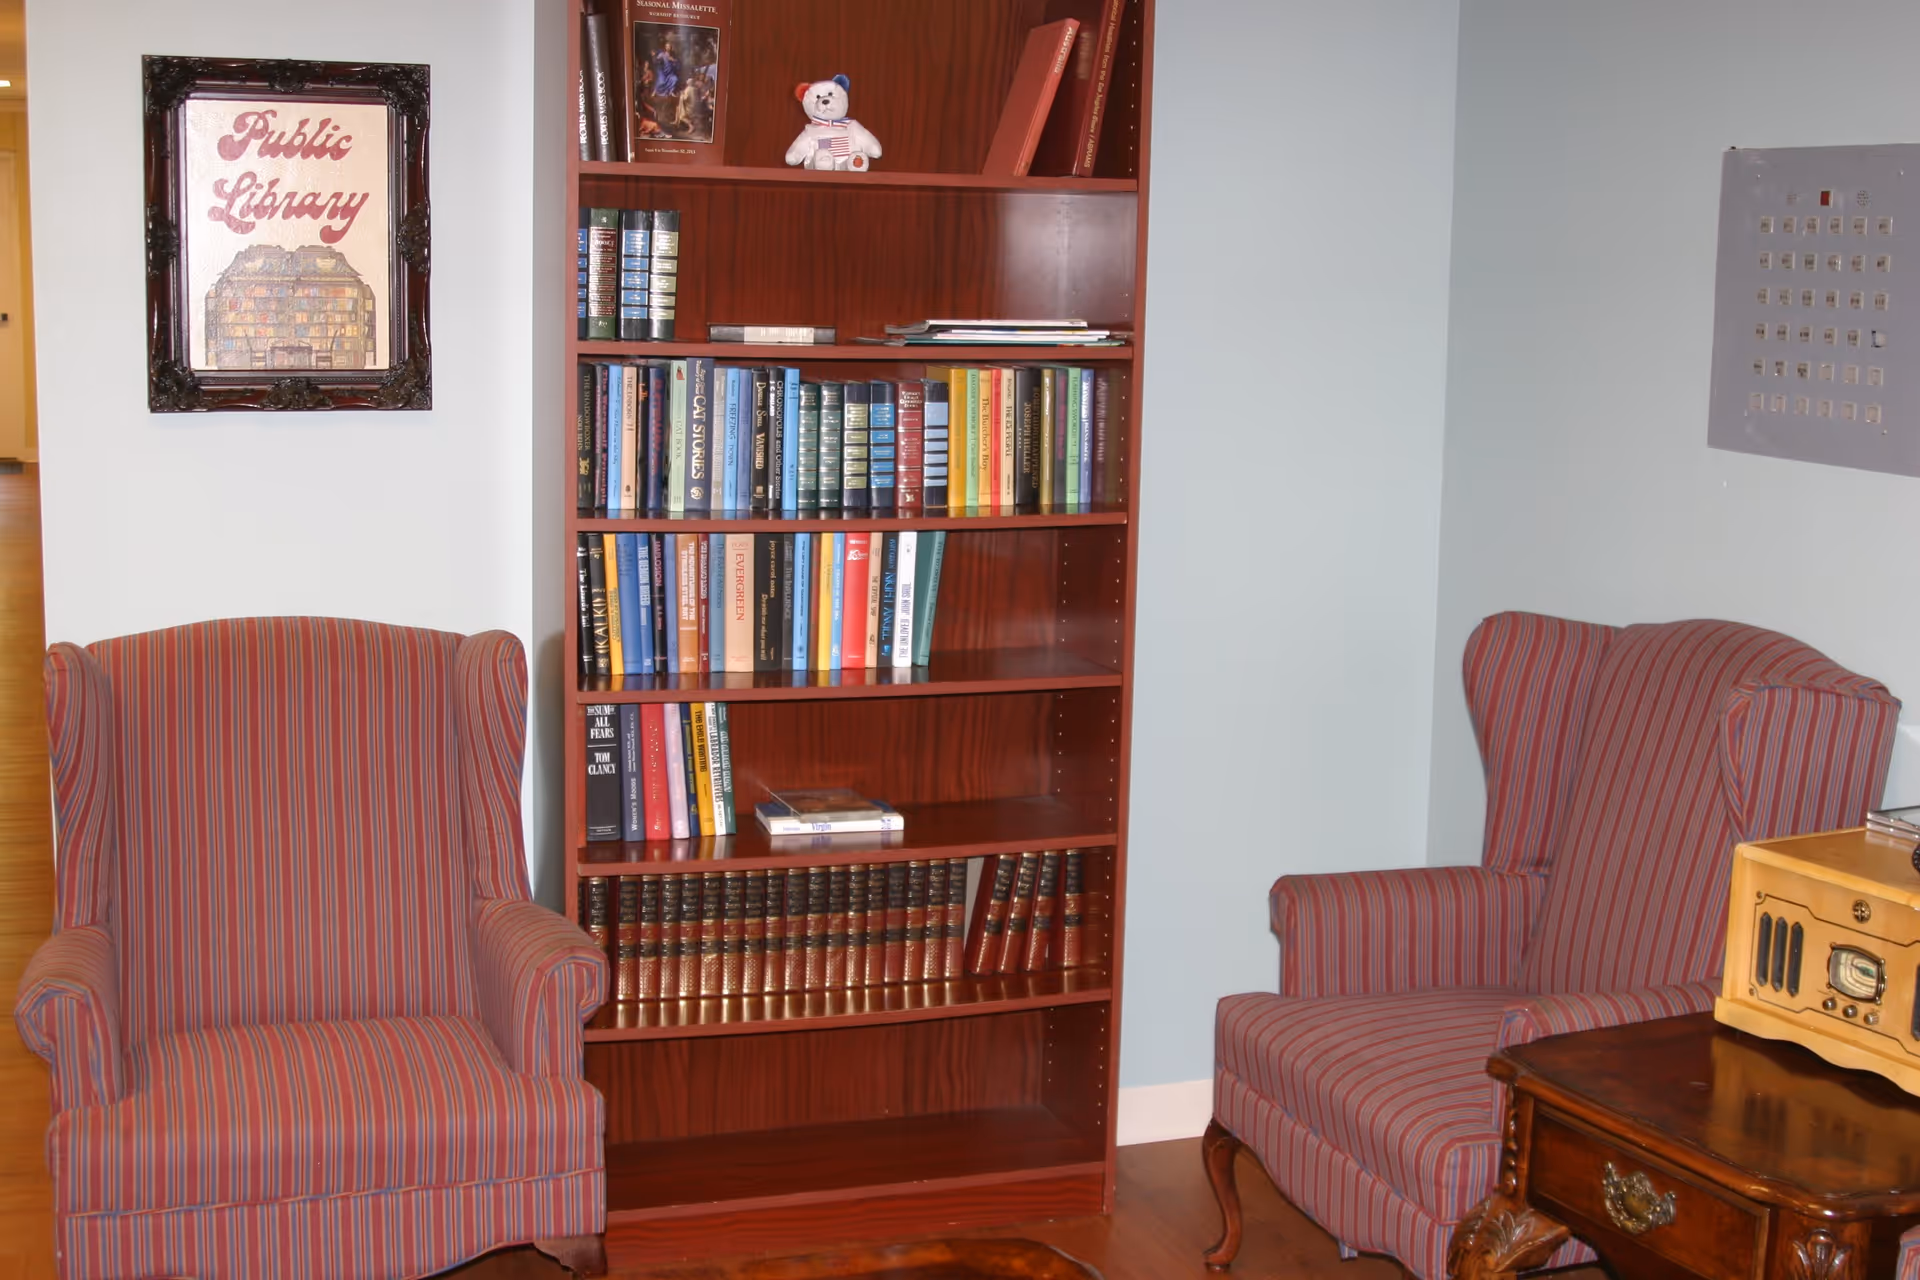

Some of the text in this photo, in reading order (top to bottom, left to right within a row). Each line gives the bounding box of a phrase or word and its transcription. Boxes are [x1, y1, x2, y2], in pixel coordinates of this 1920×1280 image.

[217, 110, 352, 161] Public
[208, 171, 369, 244] Library
[692, 396, 706, 479] CAT STORIES
[756, 433, 765, 469] VANISHED
[980, 454, 989, 471] Boy
[638, 546, 650, 606] THE DEMON BREED
[736, 554, 744, 621] EVERGREEN
[580, 585, 589, 611] Lizard's
[901, 600, 910, 615] JOHN
[900, 619, 909, 646] UNLOVED
[899, 647, 908, 658] THE
[595, 705, 610, 715] SUM
[595, 717, 610, 727] ALL
[591, 728, 614, 739] FEARS
[594, 752, 610, 763] TOM
[710, 732, 719, 765] LABRADOR
[588, 763, 616, 775] CLANCY
[713, 767, 723, 802] RETRIEVERS
[812, 822, 831, 831] Virgin
